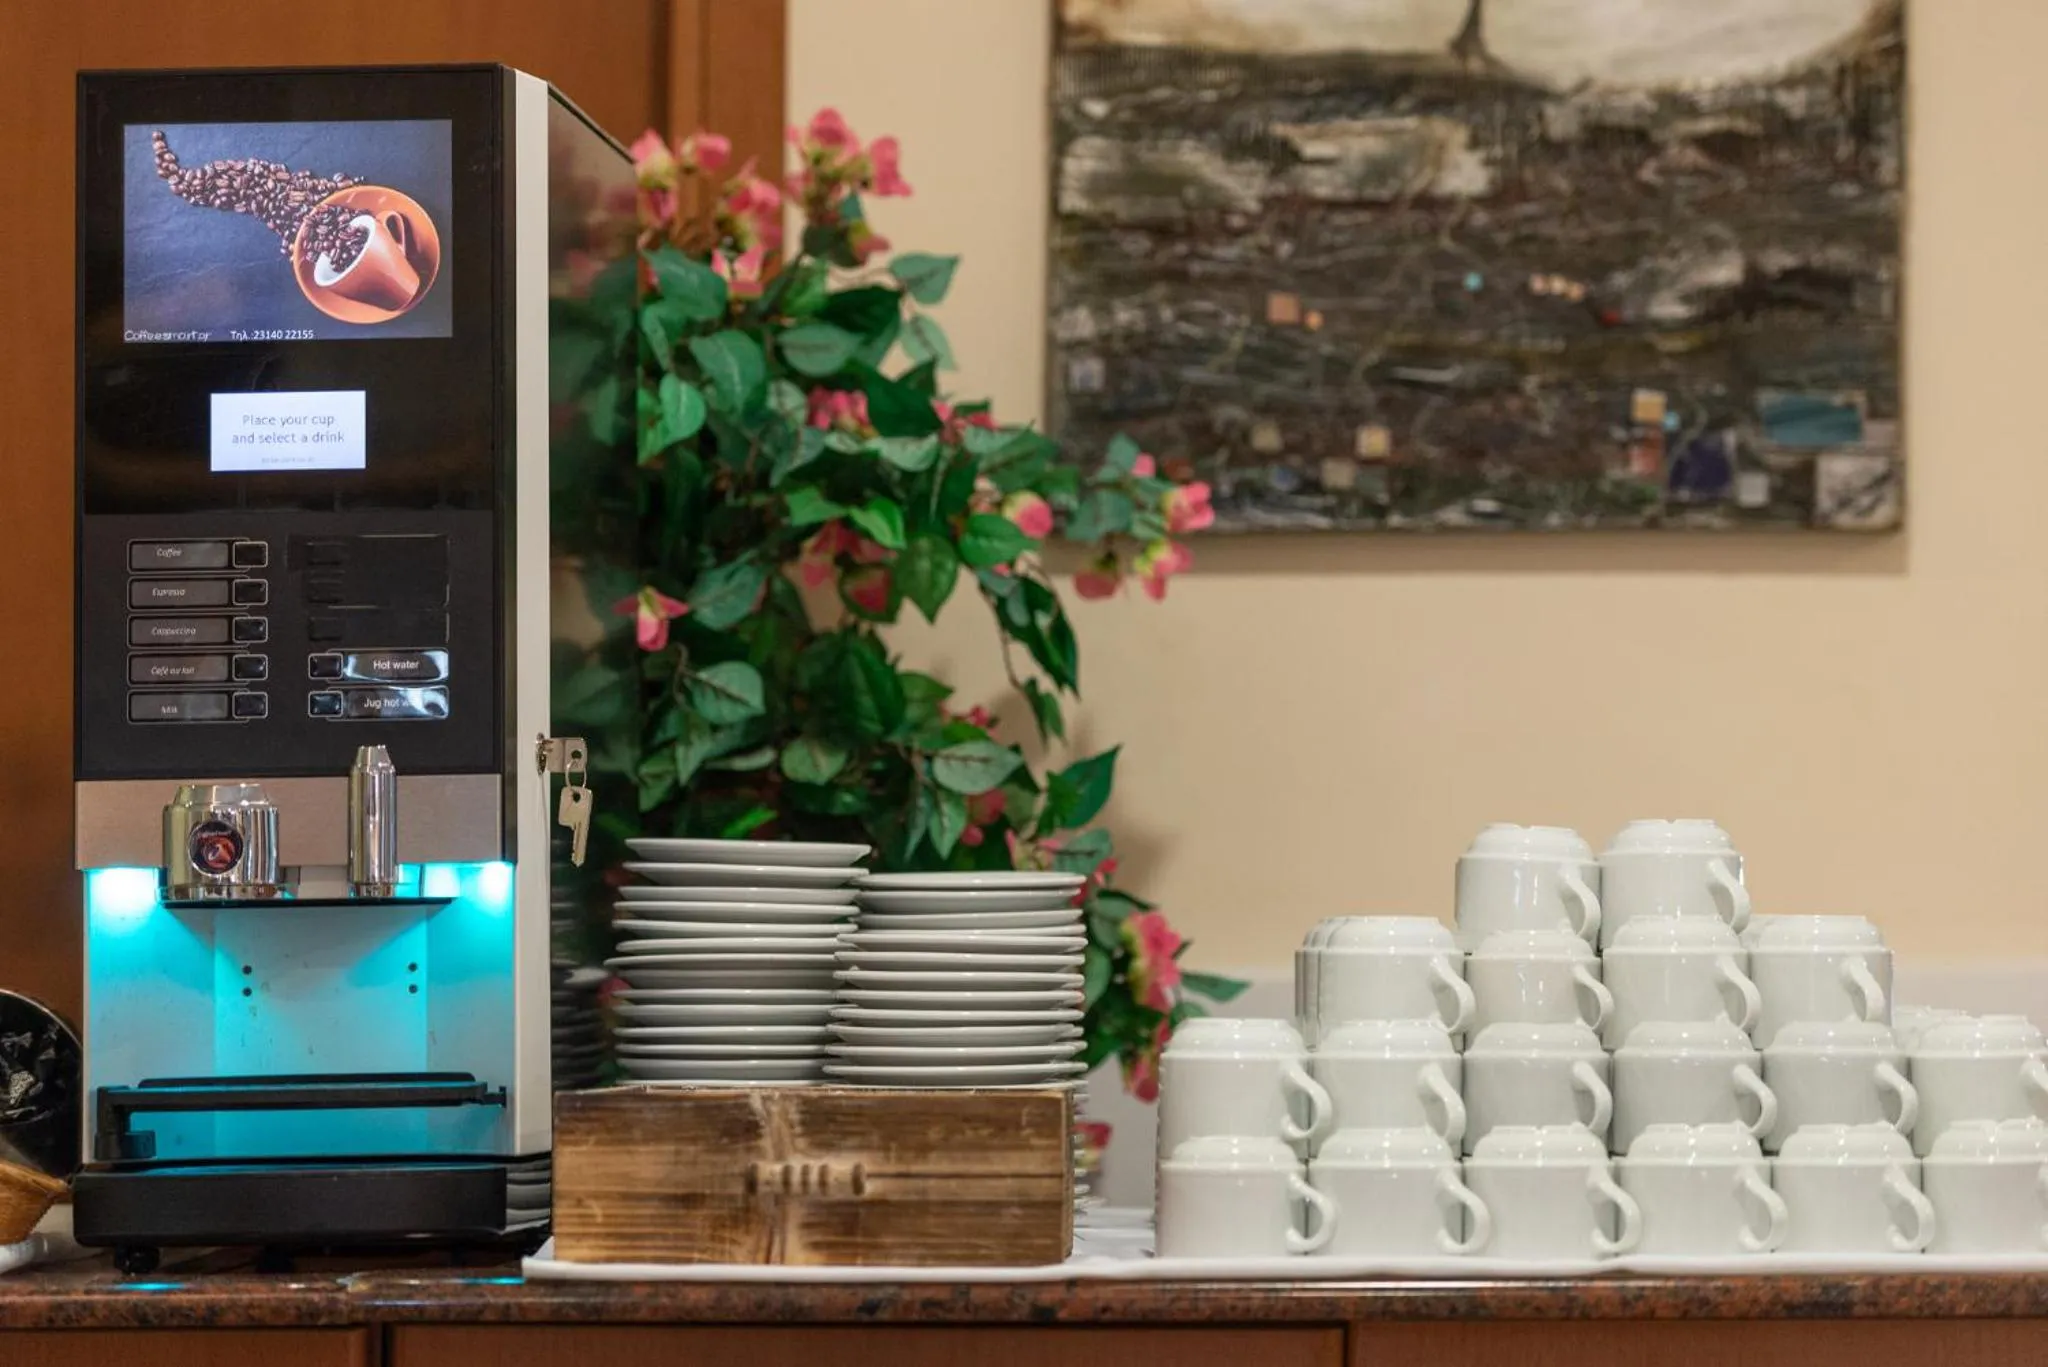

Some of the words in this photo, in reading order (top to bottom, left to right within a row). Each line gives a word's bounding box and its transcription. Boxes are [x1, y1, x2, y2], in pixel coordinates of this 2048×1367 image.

[284, 330, 315, 340] 22155
[242, 414, 276, 426] Place
[280, 415, 308, 427] your
[311, 414, 335, 427] cup
[232, 432, 255, 444] and
[258, 431, 297, 444] select
[301, 434, 308, 443] a
[312, 431, 345, 444] drink
[156, 547, 182, 558] Coffee
[373, 660, 390, 670] Hot
[393, 661, 419, 670] water
[364, 698, 382, 709] Jug
[384, 697, 399, 707] hot
